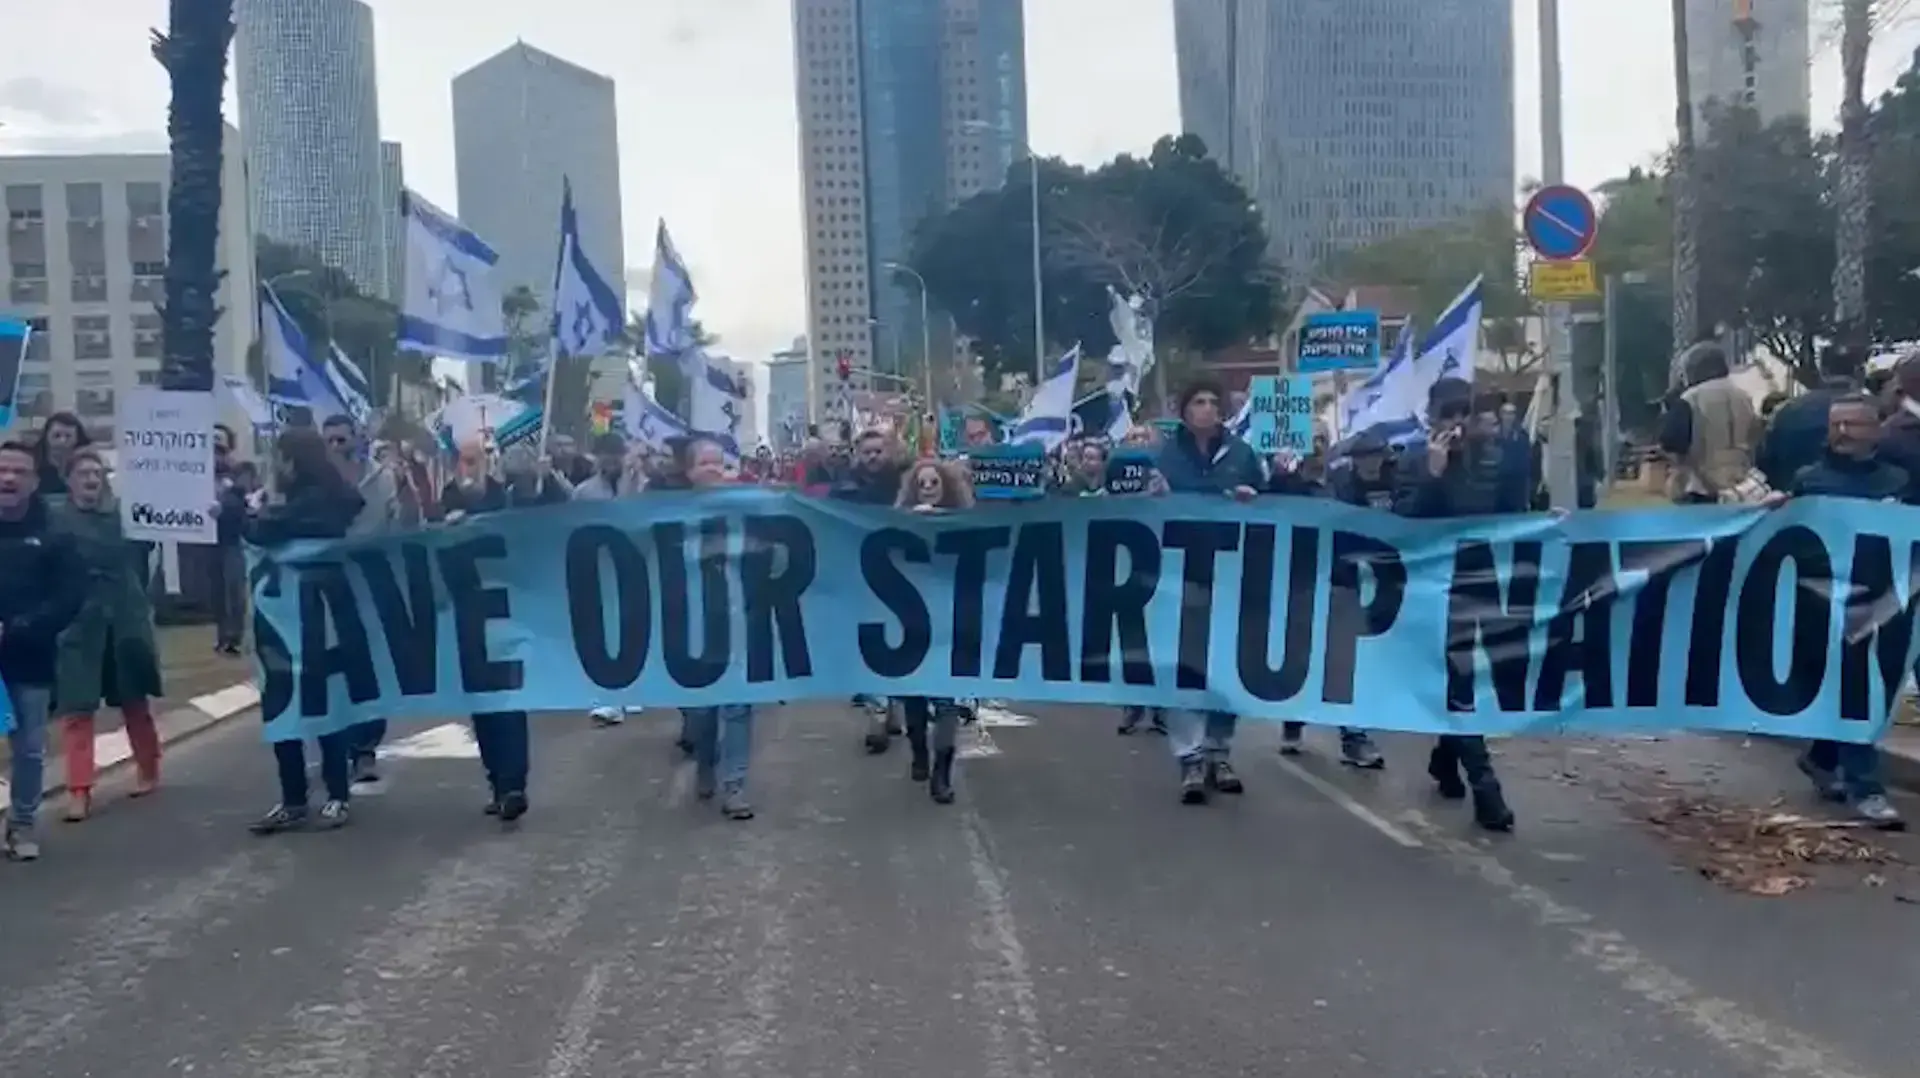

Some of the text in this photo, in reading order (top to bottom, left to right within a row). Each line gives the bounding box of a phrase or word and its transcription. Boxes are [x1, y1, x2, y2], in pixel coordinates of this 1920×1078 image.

[1274, 378, 1290, 395] NO
[1253, 396, 1311, 413] BALANCES
[1275, 414, 1290, 431] NO
[124, 430, 208, 452] דמוקרטיה
[1261, 431, 1306, 449] CHECKS
[250, 512, 1920, 723] SAVE OUR STARTUP NATION
